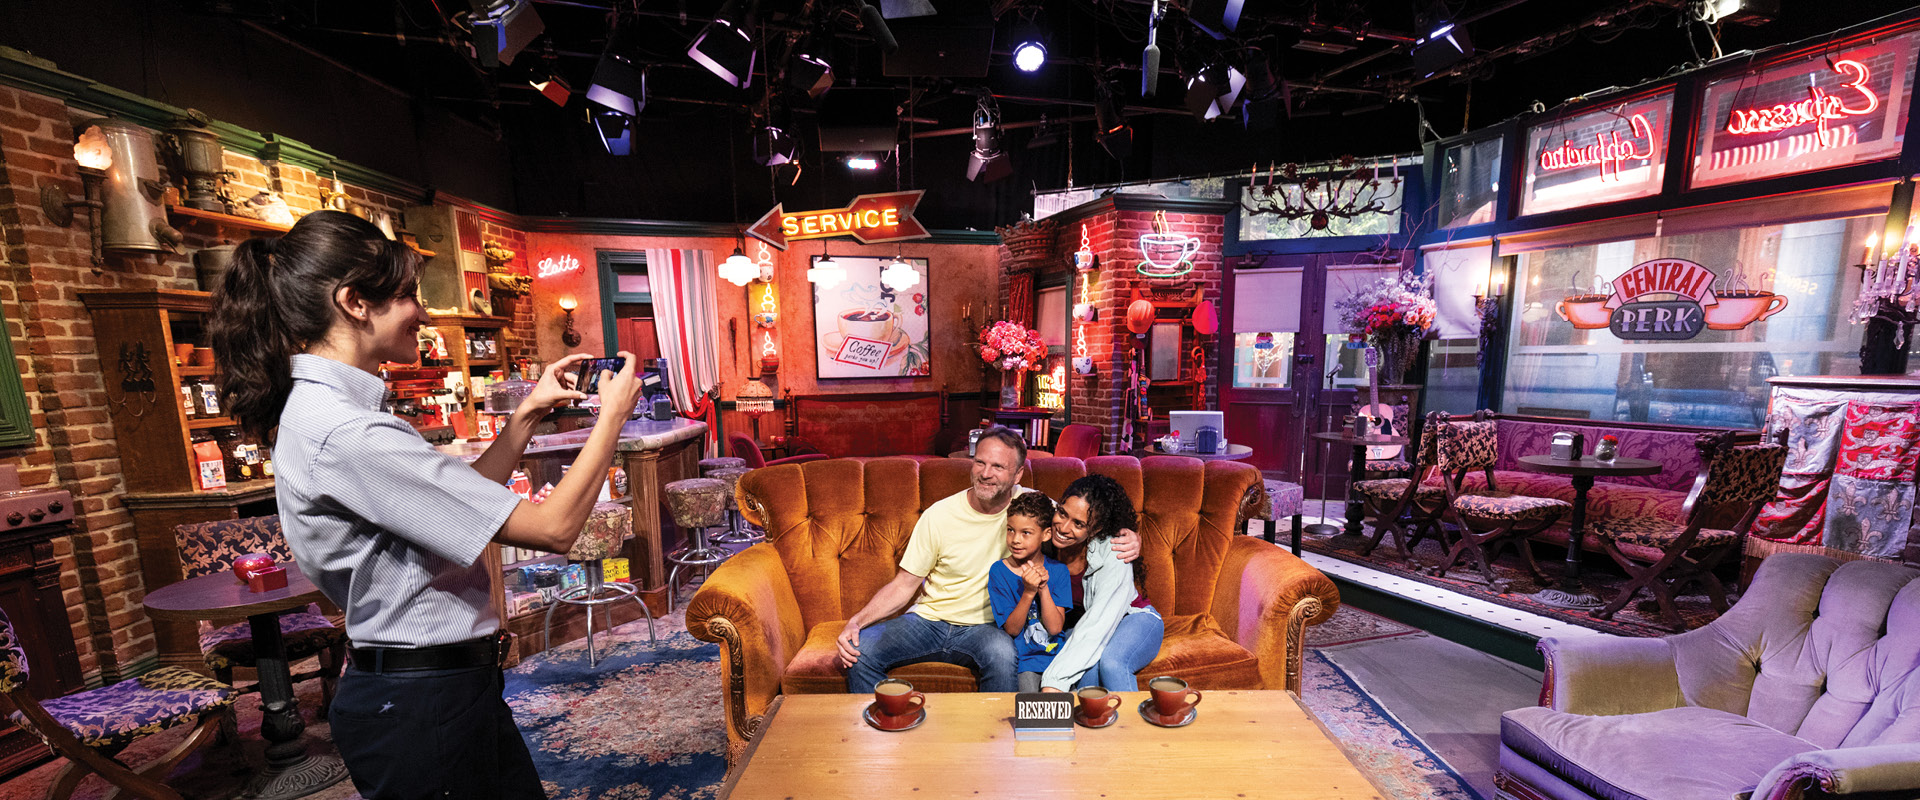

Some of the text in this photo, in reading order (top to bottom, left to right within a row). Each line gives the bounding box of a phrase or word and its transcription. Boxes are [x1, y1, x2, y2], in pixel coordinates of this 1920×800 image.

[781, 207, 900, 236] SERVICE
[537, 253, 580, 279] Latte
[1620, 261, 1708, 299] CENTRAL
[1620, 306, 1696, 333] PERK
[848, 340, 882, 358] Coffee
[1017, 700, 1072, 720] RESERVED
